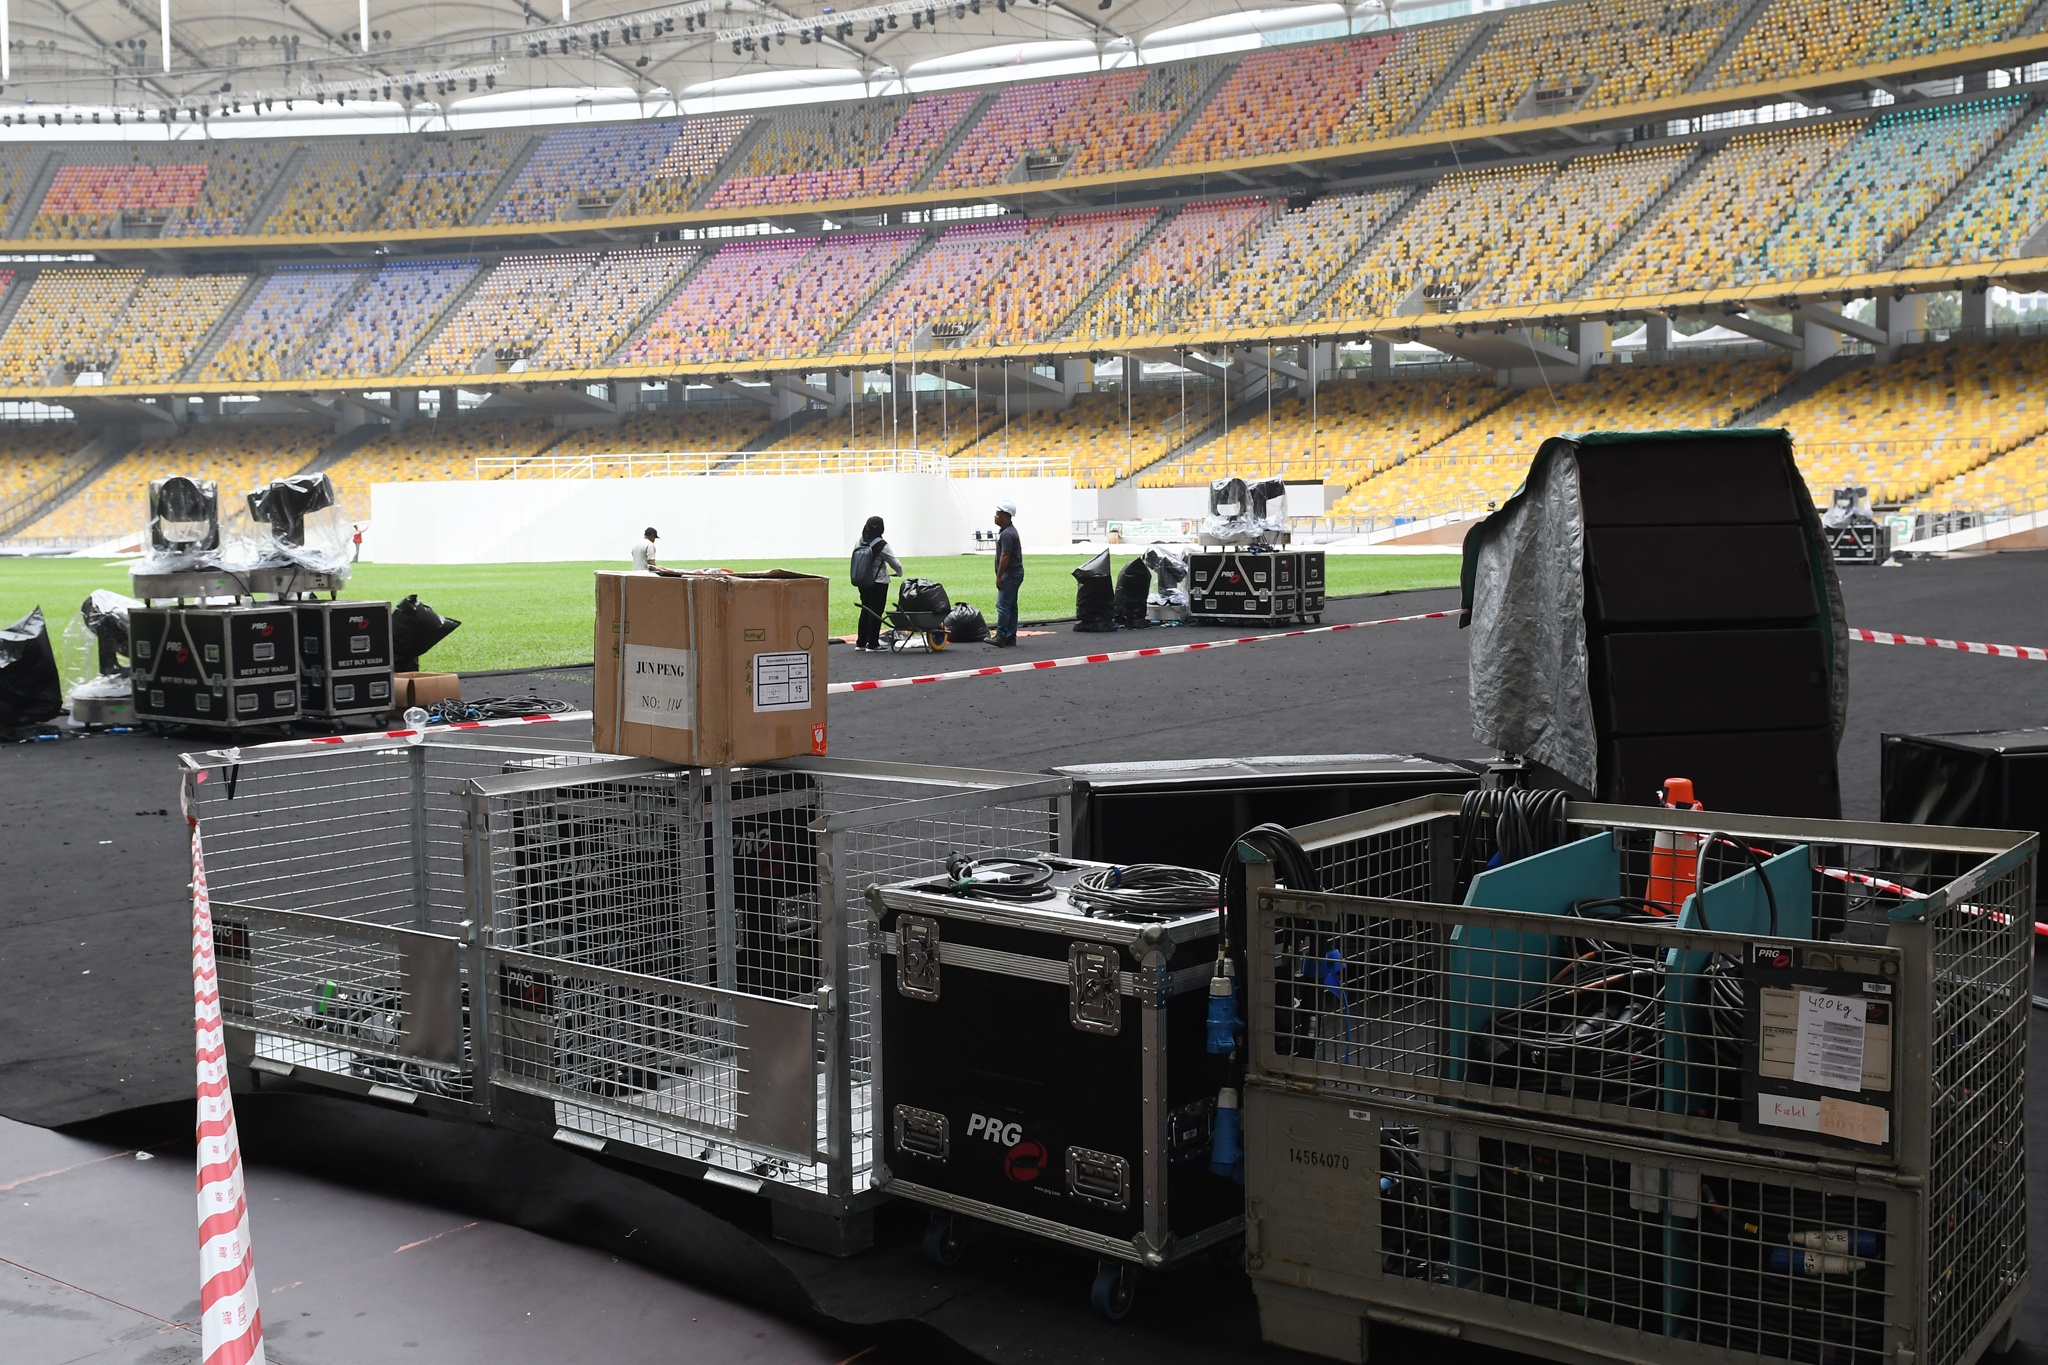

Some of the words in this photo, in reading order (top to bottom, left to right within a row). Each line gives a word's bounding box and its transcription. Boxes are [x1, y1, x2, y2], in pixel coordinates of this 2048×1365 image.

[349, 615, 364, 623] PRG
[252, 622, 267, 631] PRG
[166, 641, 182, 652] PRG
[271, 665, 288, 673] WASH
[636, 661, 654, 675] JUN
[657, 663, 684, 677] PENG
[795, 685, 802, 693] 15
[642, 695, 660, 709] NO:
[1758, 949, 1780, 960] PRG
[508, 971, 533, 988] PRG
[1808, 995, 1834, 1009] 420
[966, 1112, 1023, 1147] PRG
[1289, 1148, 1350, 1170] 14564070
[1033, 1185, 1061, 1197] www.prg.com
